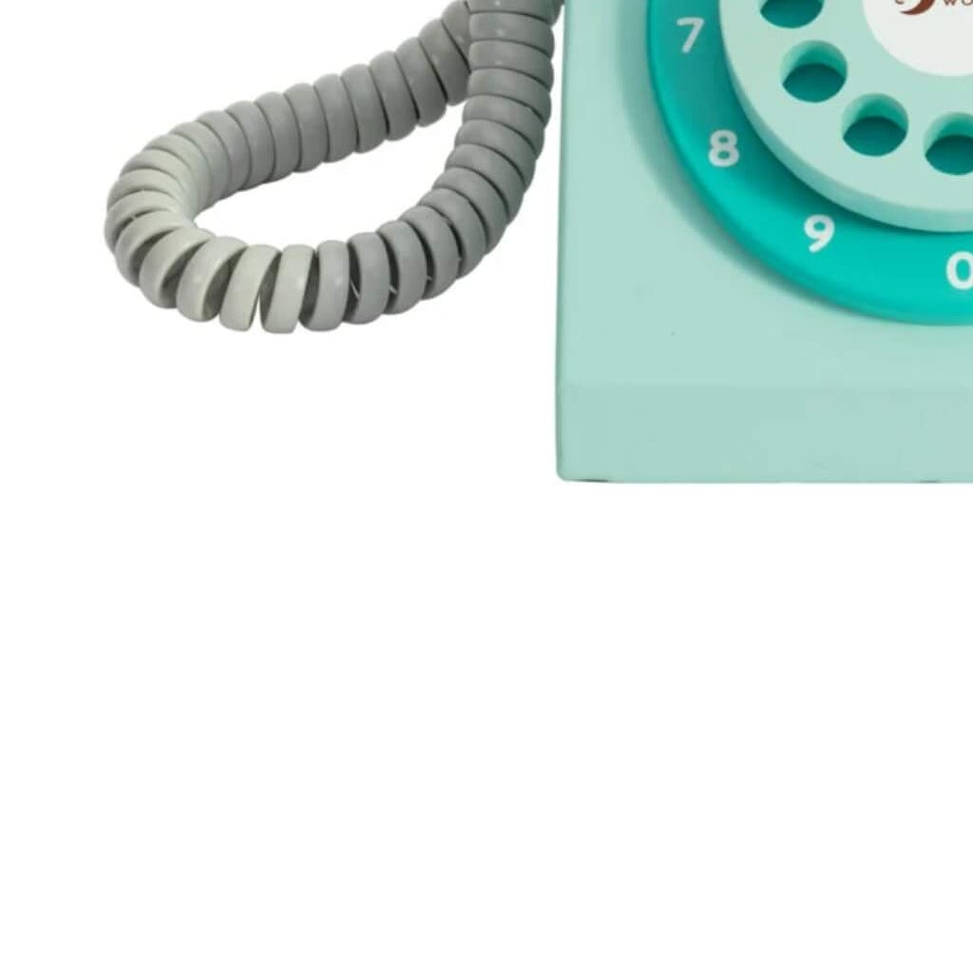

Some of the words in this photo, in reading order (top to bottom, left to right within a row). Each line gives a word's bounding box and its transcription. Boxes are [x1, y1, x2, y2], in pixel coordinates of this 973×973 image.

[676, 17, 704, 53] 7
[708, 130, 739, 167] 8
[804, 214, 835, 252] 9
